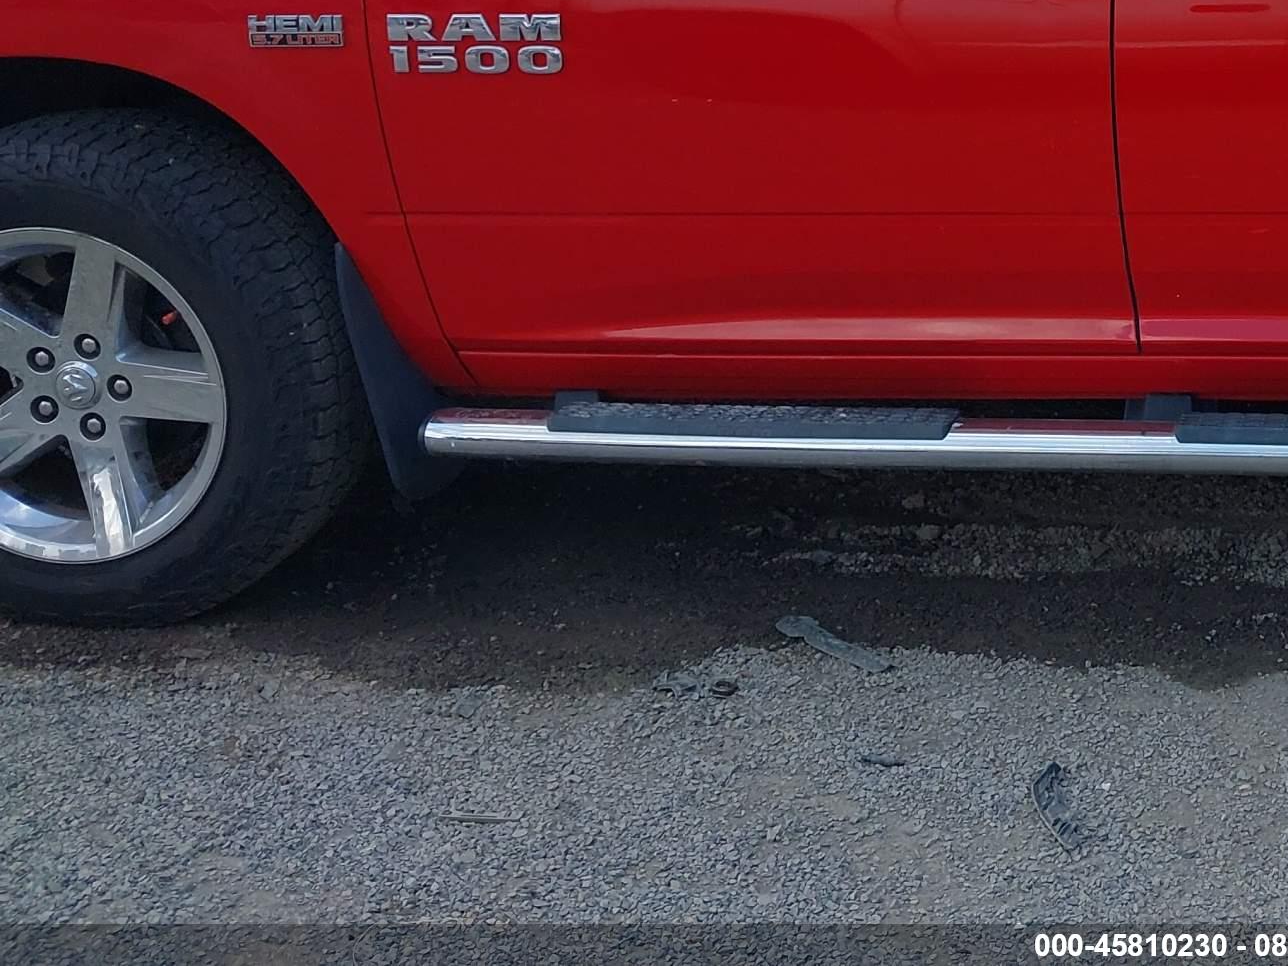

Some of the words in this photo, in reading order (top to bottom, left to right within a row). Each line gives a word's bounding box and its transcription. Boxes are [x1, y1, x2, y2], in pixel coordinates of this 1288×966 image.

[247, 14, 343, 32] HEMI
[386, 13, 562, 42] RAM
[252, 34, 283, 45] 5.7
[286, 34, 339, 45] LITER
[389, 45, 564, 75] 1500
